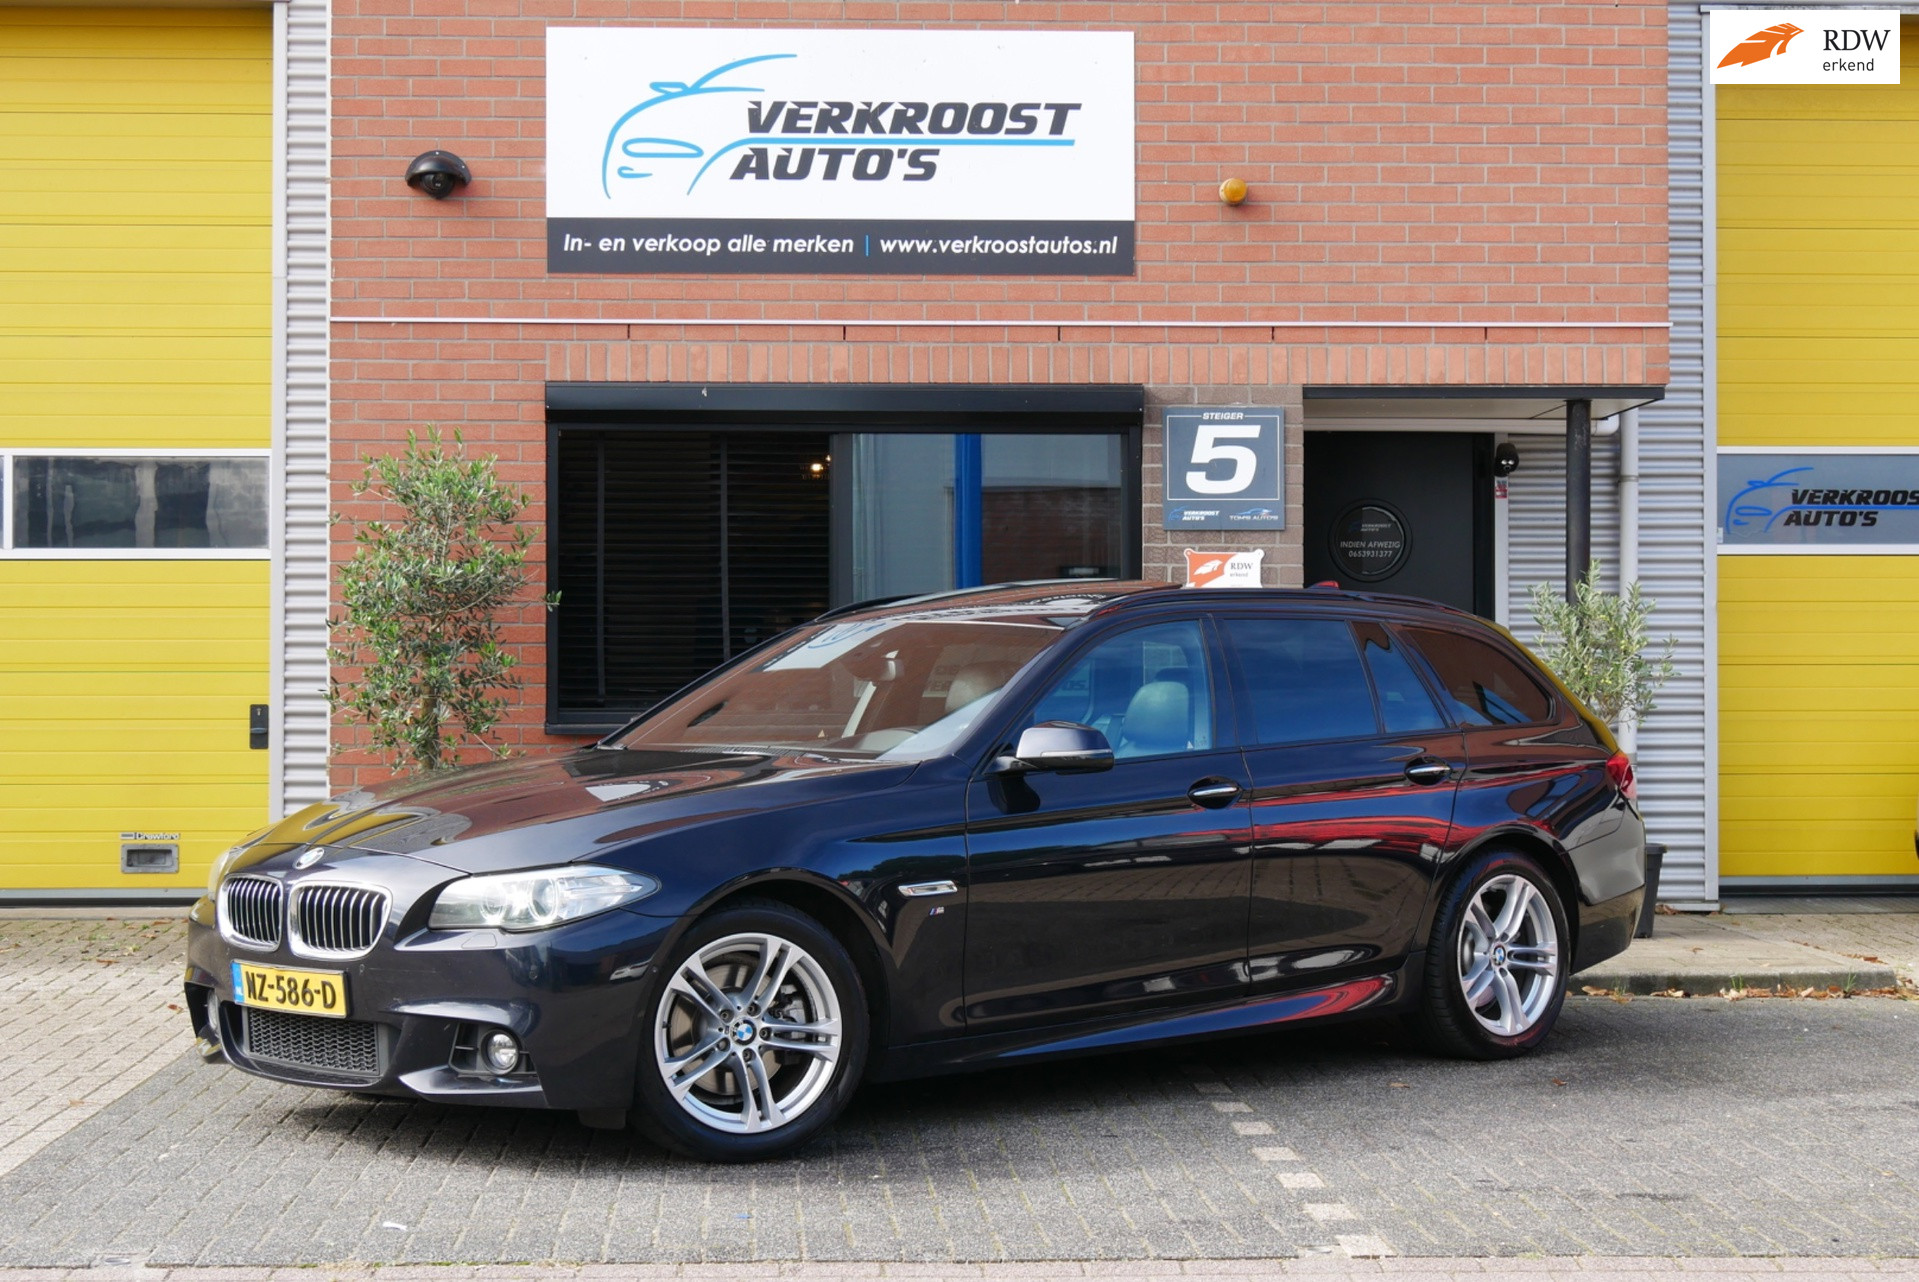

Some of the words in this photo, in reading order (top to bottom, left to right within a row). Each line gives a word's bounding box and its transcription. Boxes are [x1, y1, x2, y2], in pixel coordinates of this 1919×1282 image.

[747, 100, 1082, 136] VERKROOST
[729, 147, 940, 181] AUTO'S
[563, 233, 592, 252] In-
[599, 238, 626, 252] en
[632, 233, 721, 257] verkoop
[727, 234, 766, 253] alle
[772, 235, 854, 254] merken
[880, 236, 1118, 256] www.verkroostautos.nl
[1203, 412, 1244, 420] STEIGER
[1186, 425, 1261, 494] 5
[1784, 511, 1878, 527] AUTO'S
[1230, 562, 1253, 570] RDW
[245, 971, 336, 1009] NZ-586-D
